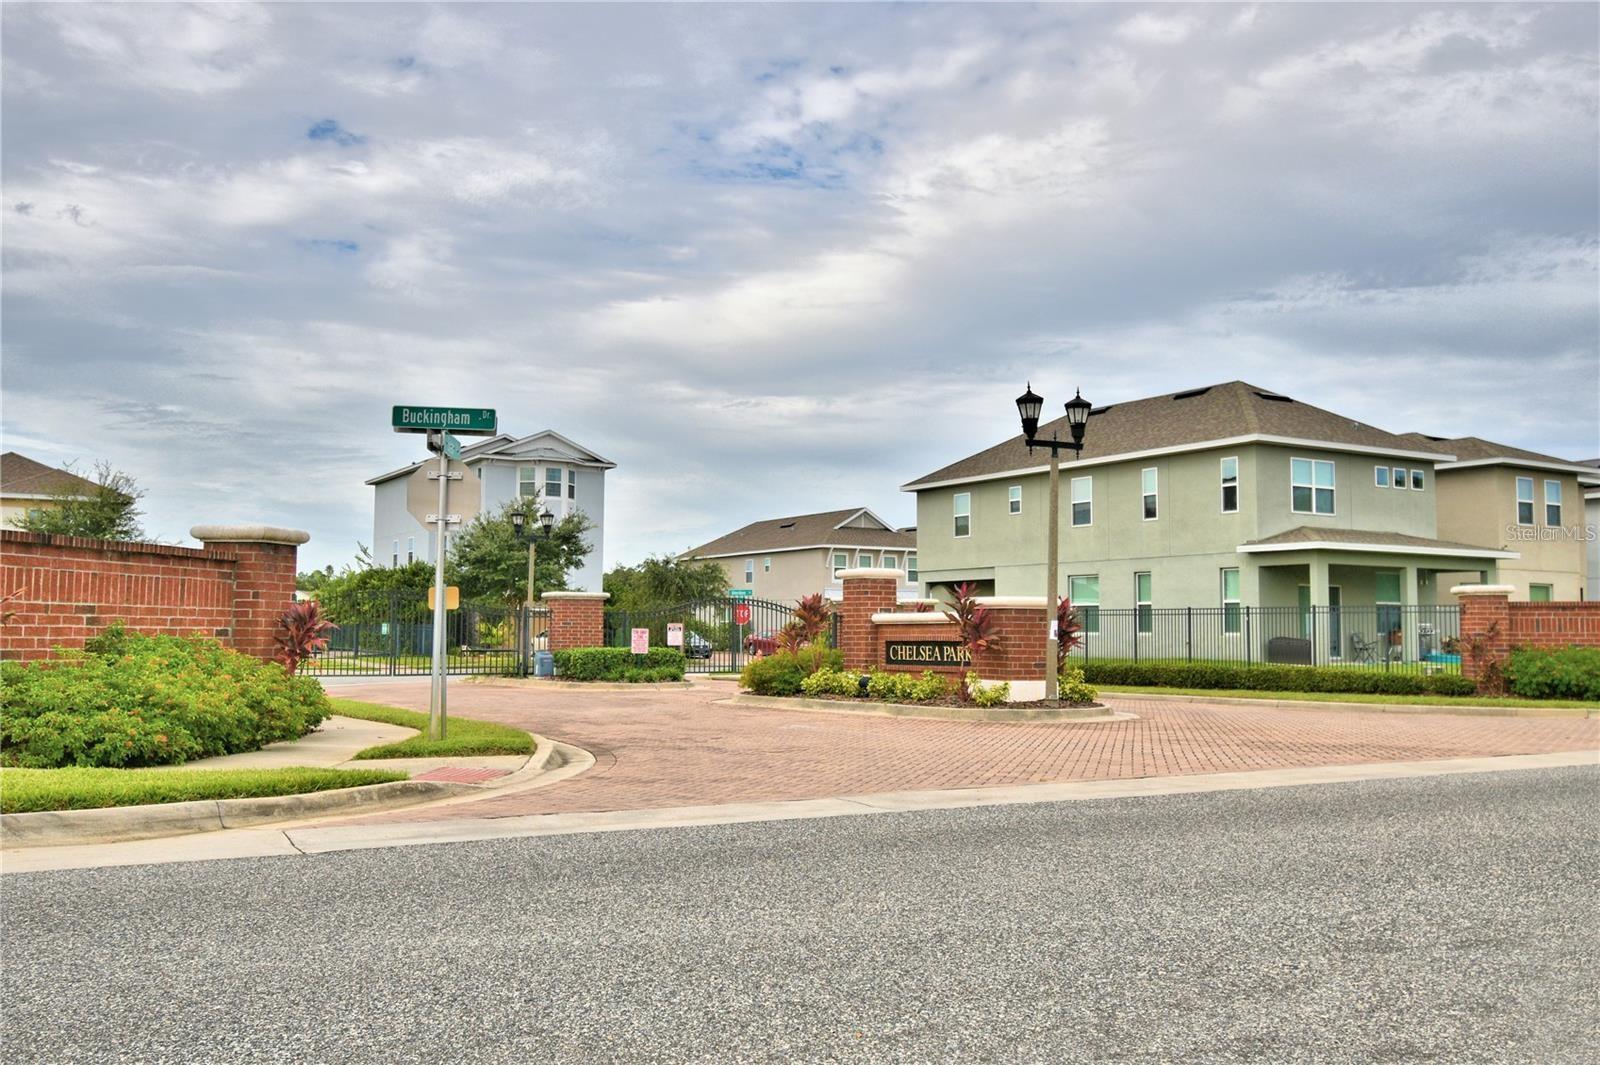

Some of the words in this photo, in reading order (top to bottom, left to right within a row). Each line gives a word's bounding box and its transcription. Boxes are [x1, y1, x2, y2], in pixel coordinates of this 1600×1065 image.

[402, 408, 471, 426] Buckingham
[889, 645, 941, 661] CHELSEA
[943, 646, 972, 662] PARK
